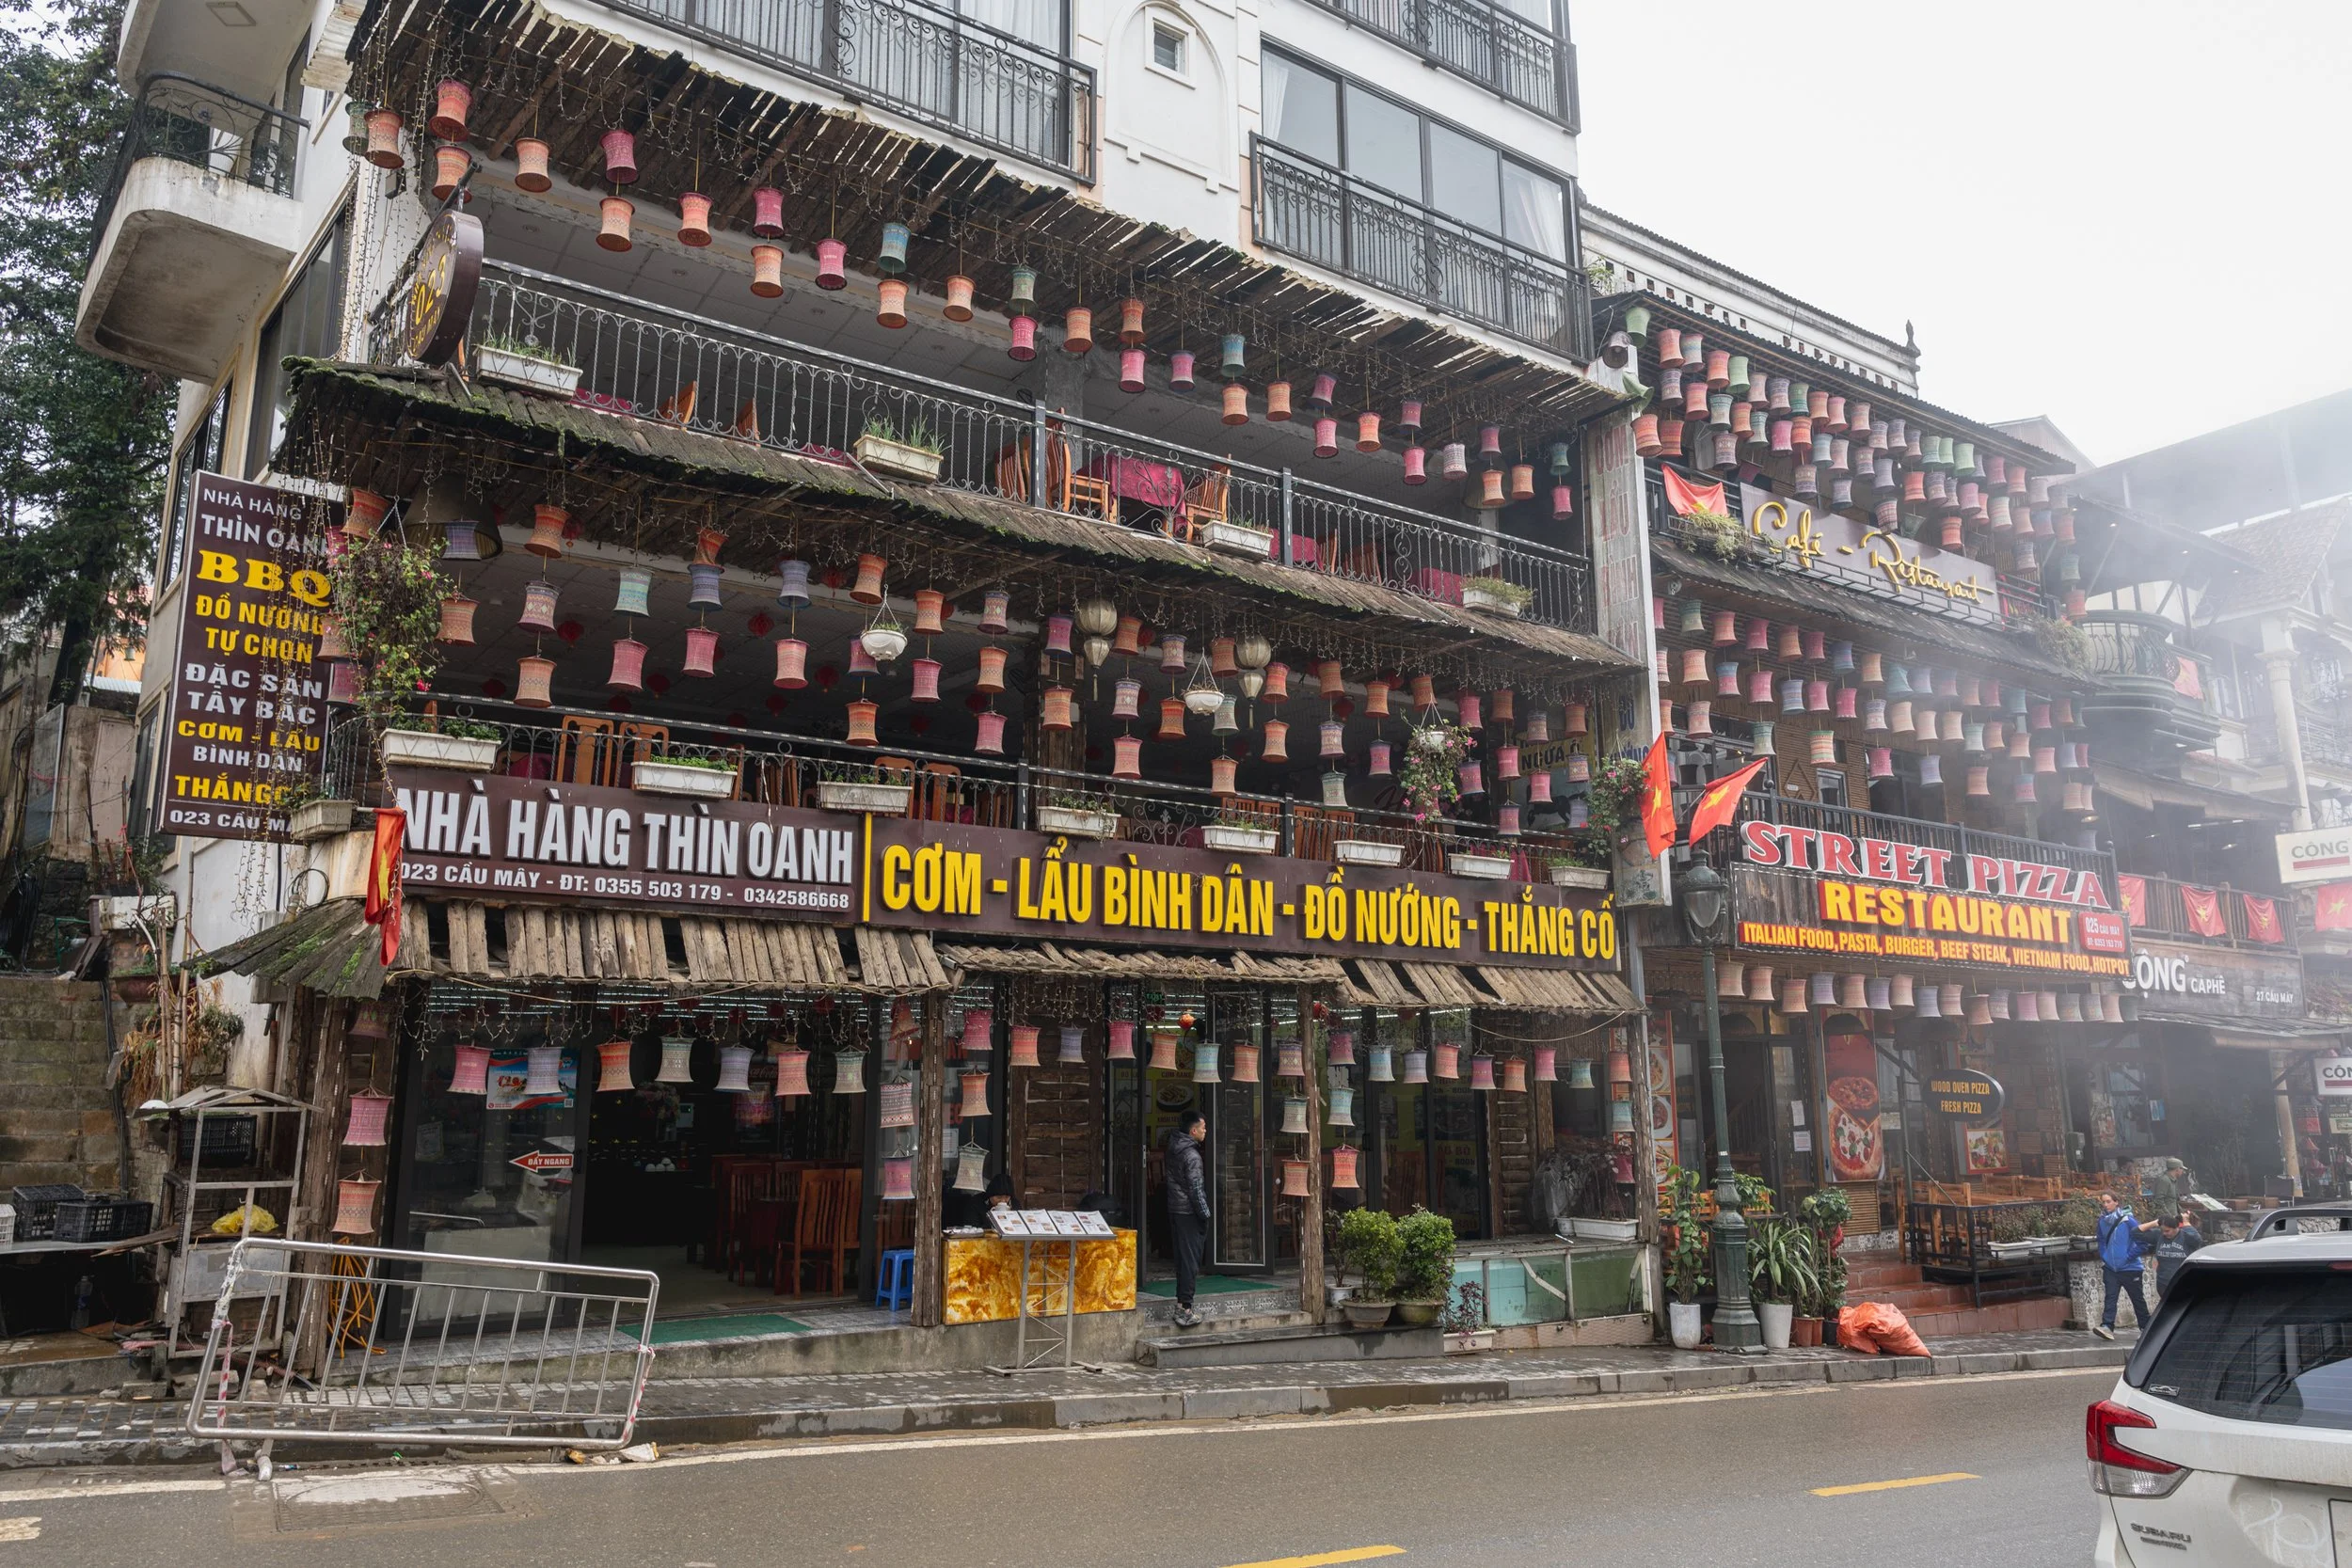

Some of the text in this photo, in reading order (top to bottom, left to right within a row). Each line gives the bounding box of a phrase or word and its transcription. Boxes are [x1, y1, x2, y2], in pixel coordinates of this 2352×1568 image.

[203, 488, 302, 520] NHÀ HÀNG
[201, 514, 261, 546] THÌN
[196, 549, 331, 607] BBQ
[196, 592, 324, 635] ĐỒ NƯỚNG
[205, 627, 313, 664] TỰ CHỌN
[185, 662, 323, 699] ĐẶC SẢN
[187, 690, 316, 725] TÂY BẮC
[178, 720, 243, 743] CƠM
[269, 728, 320, 752] LẨU
[193, 744, 250, 767] BÌNH
[174, 772, 272, 805] THẮNG
[169, 810, 211, 825] 023
[217, 812, 261, 830] CẦU
[396, 779, 853, 884] NHÀ HÀNG THÌN OANH
[1741, 820, 2111, 909] STREET PIZZA
[402, 863, 437, 880] 023
[444, 862, 488, 884] CẦU
[494, 868, 540, 888] MÂY
[559, 874, 589, 892] ĐT:
[595, 876, 643, 895] 0355
[647, 880, 683, 899] 503
[690, 883, 722, 901] 179
[744, 888, 850, 909] 0342586668
[882, 842, 982, 915] CƠM
[1017, 836, 1092, 923] LẨU
[1104, 853, 1192, 930] BÌNH
[1200, 863, 1274, 935] DÂN
[1304, 866, 1347, 941] ĐỒ
[1356, 882, 1460, 948] NƯỚNG
[1483, 885, 1574, 956] THẮNG
[1581, 894, 1615, 958] CỐ
[1821, 880, 2071, 942] RESTAURANT
[2085, 916, 2099, 934] 025
[1743, 922, 1796, 946] ITALIAN
[1885, 935, 1937, 961] BURGER,
[1941, 939, 1969, 959] BEEF
[1972, 943, 2010, 967] STEAK,
[2012, 947, 2062, 970] VIETNAM
[2122, 947, 2186, 999] ỘNG
[1931, 1080, 1991, 1095] WOOD OVEN PIZZA
[1941, 1100, 1982, 1115] FRESH PIZZA
[2130, 1522, 2192, 1544] SUBARU
